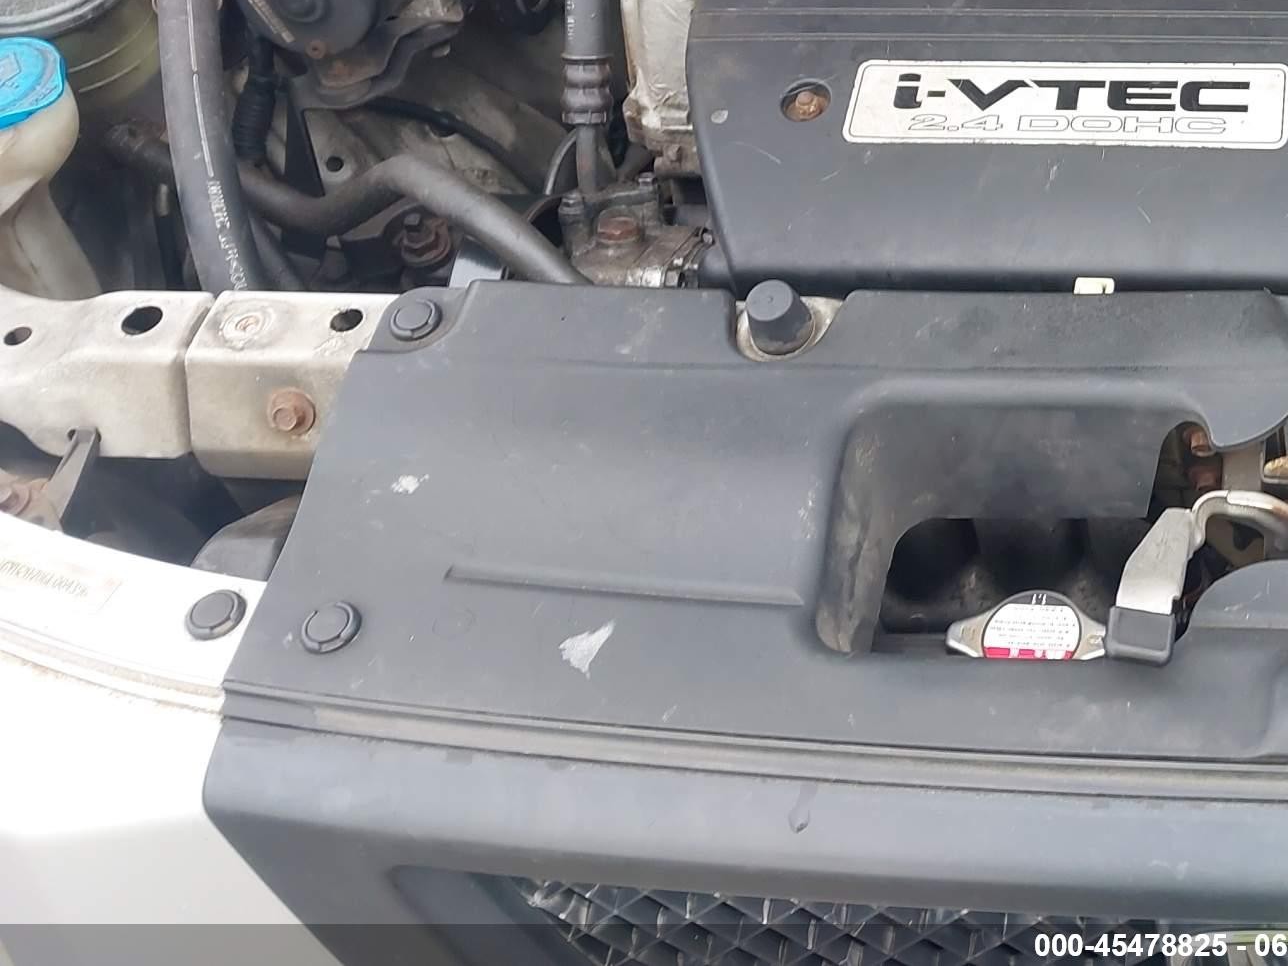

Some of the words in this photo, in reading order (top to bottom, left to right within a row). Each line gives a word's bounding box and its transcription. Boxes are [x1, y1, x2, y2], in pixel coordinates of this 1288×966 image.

[893, 72, 1251, 112] i-VTEC
[907, 113, 1003, 131] 2.4
[1017, 114, 1227, 134] DOHC
